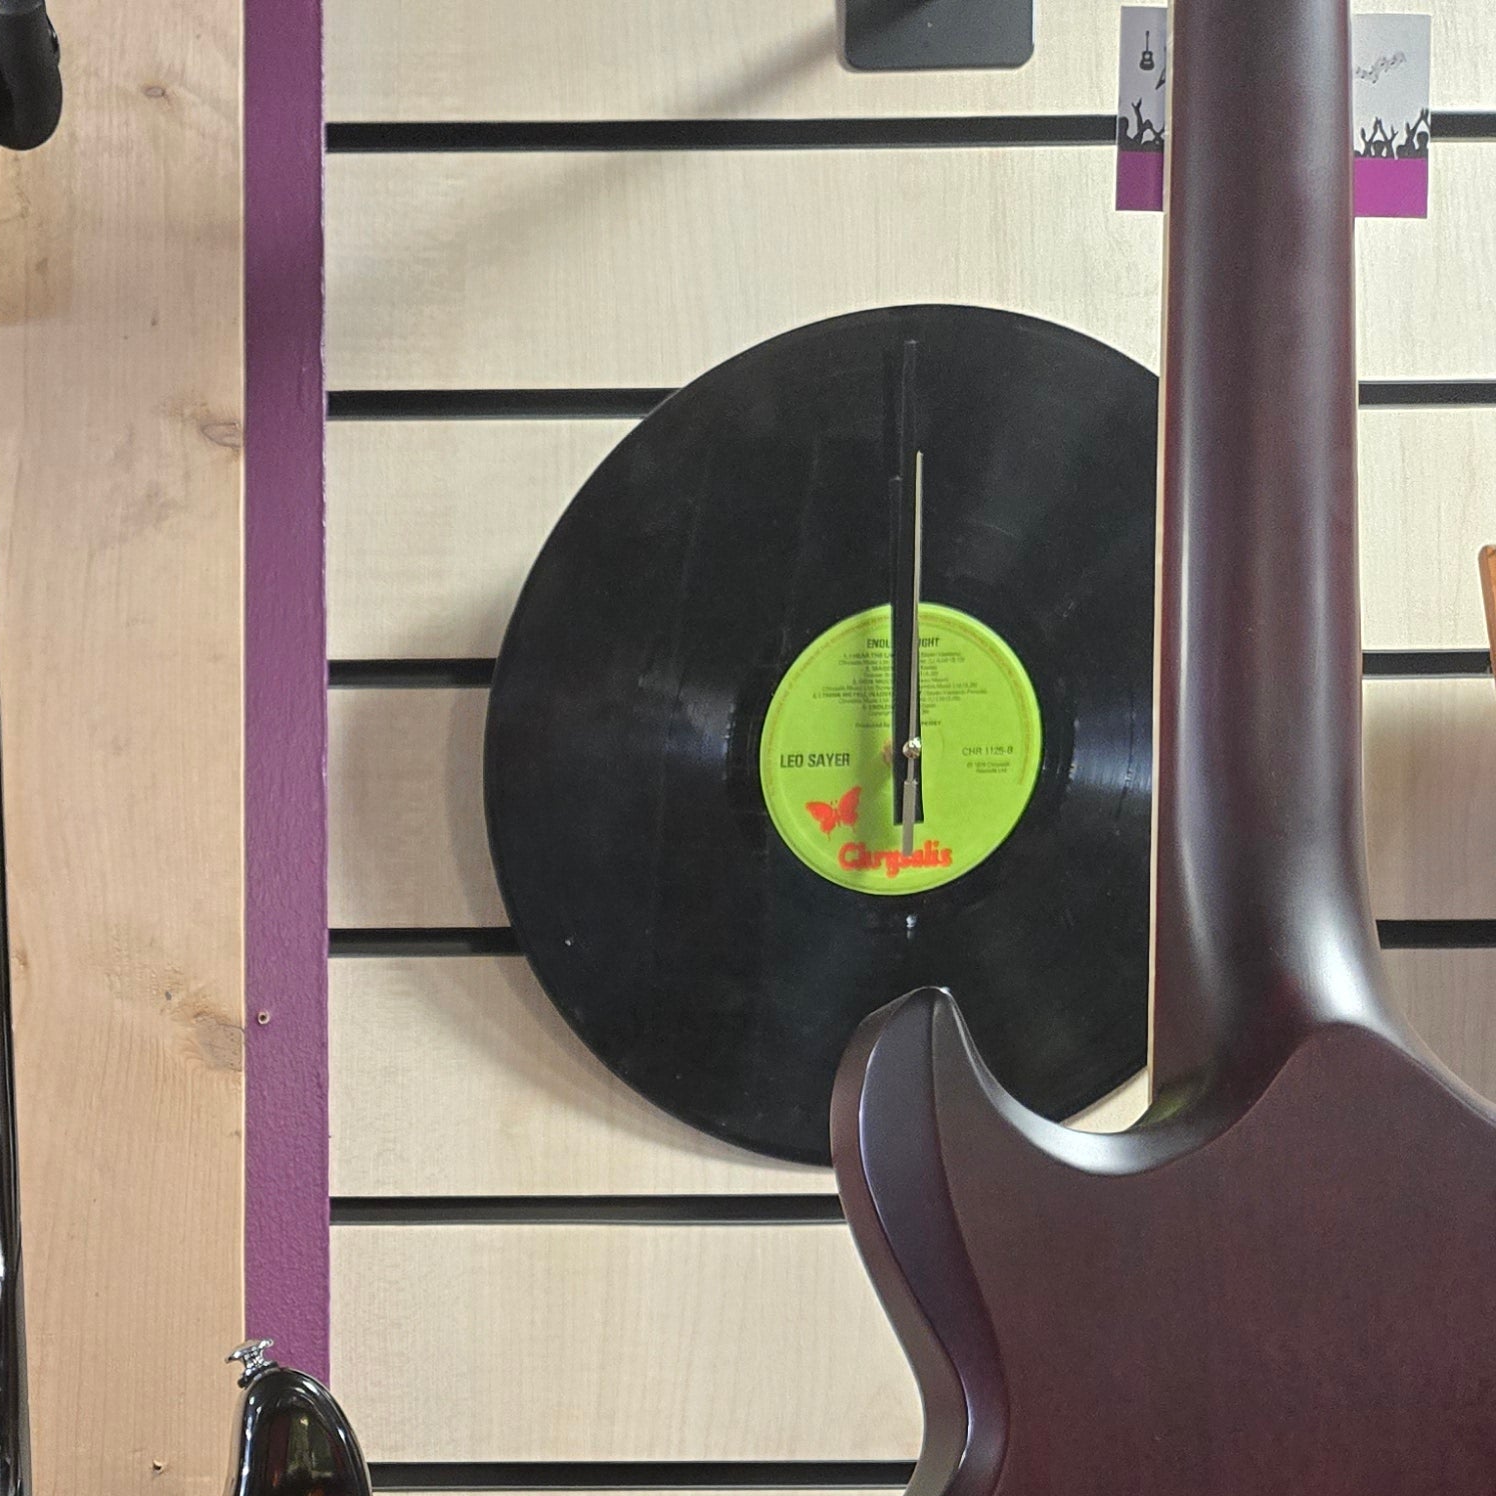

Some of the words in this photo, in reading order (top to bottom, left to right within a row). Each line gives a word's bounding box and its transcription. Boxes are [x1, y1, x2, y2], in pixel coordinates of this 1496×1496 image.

[962, 746, 982, 757] CHR
[779, 754, 804, 768] LEO
[807, 753, 851, 768] SAYER
